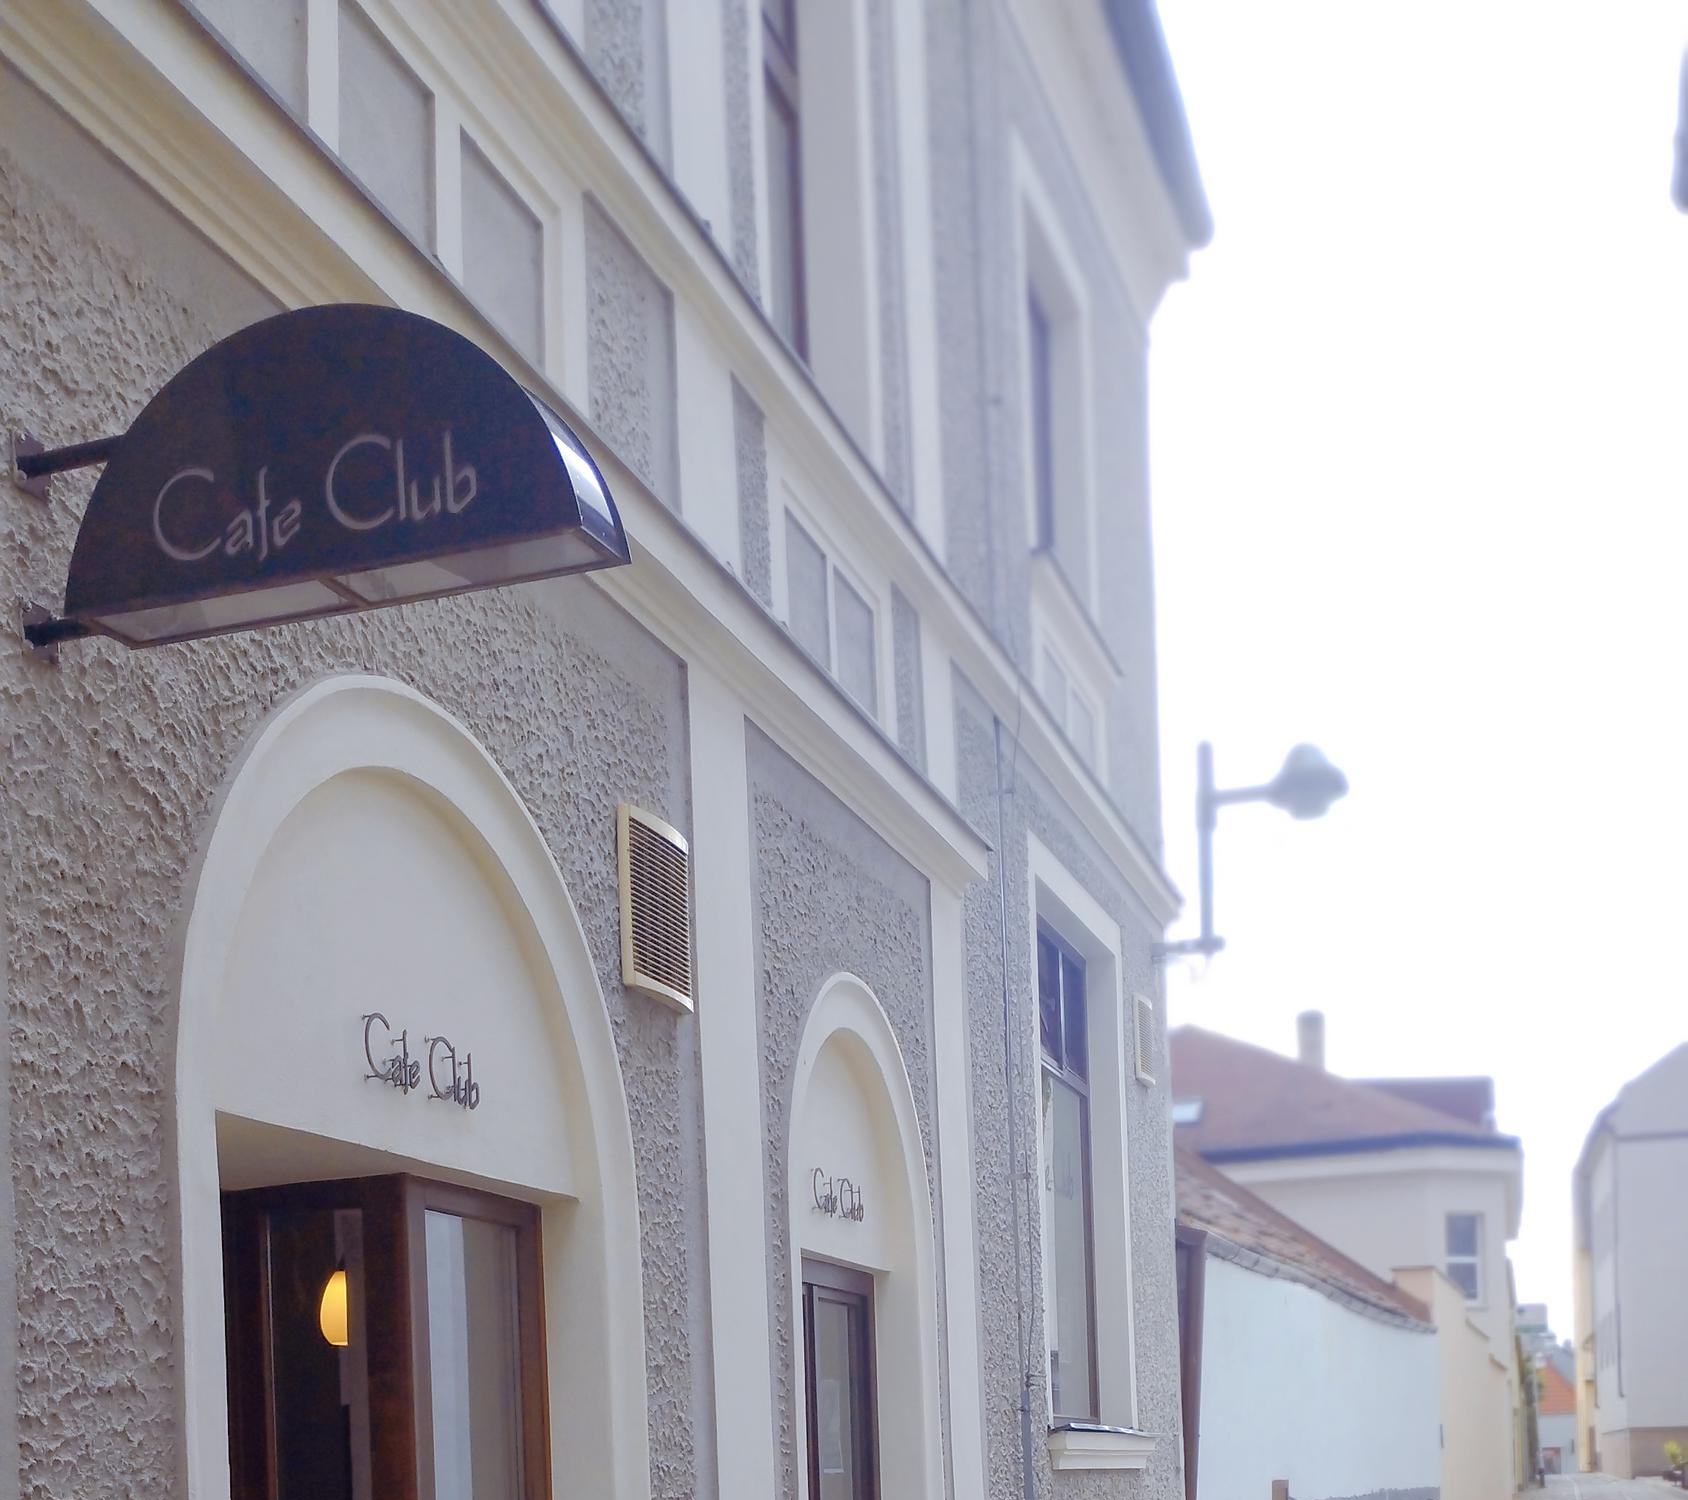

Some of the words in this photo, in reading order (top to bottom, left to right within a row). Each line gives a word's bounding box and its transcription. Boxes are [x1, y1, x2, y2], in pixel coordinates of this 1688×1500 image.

[152, 466, 302, 561] Cafe
[325, 429, 478, 531] Club
[363, 1012, 421, 1095] Cafe
[428, 1035, 480, 1110] Club
[813, 1167, 838, 1218] Cafe
[839, 1178, 864, 1222] Club
